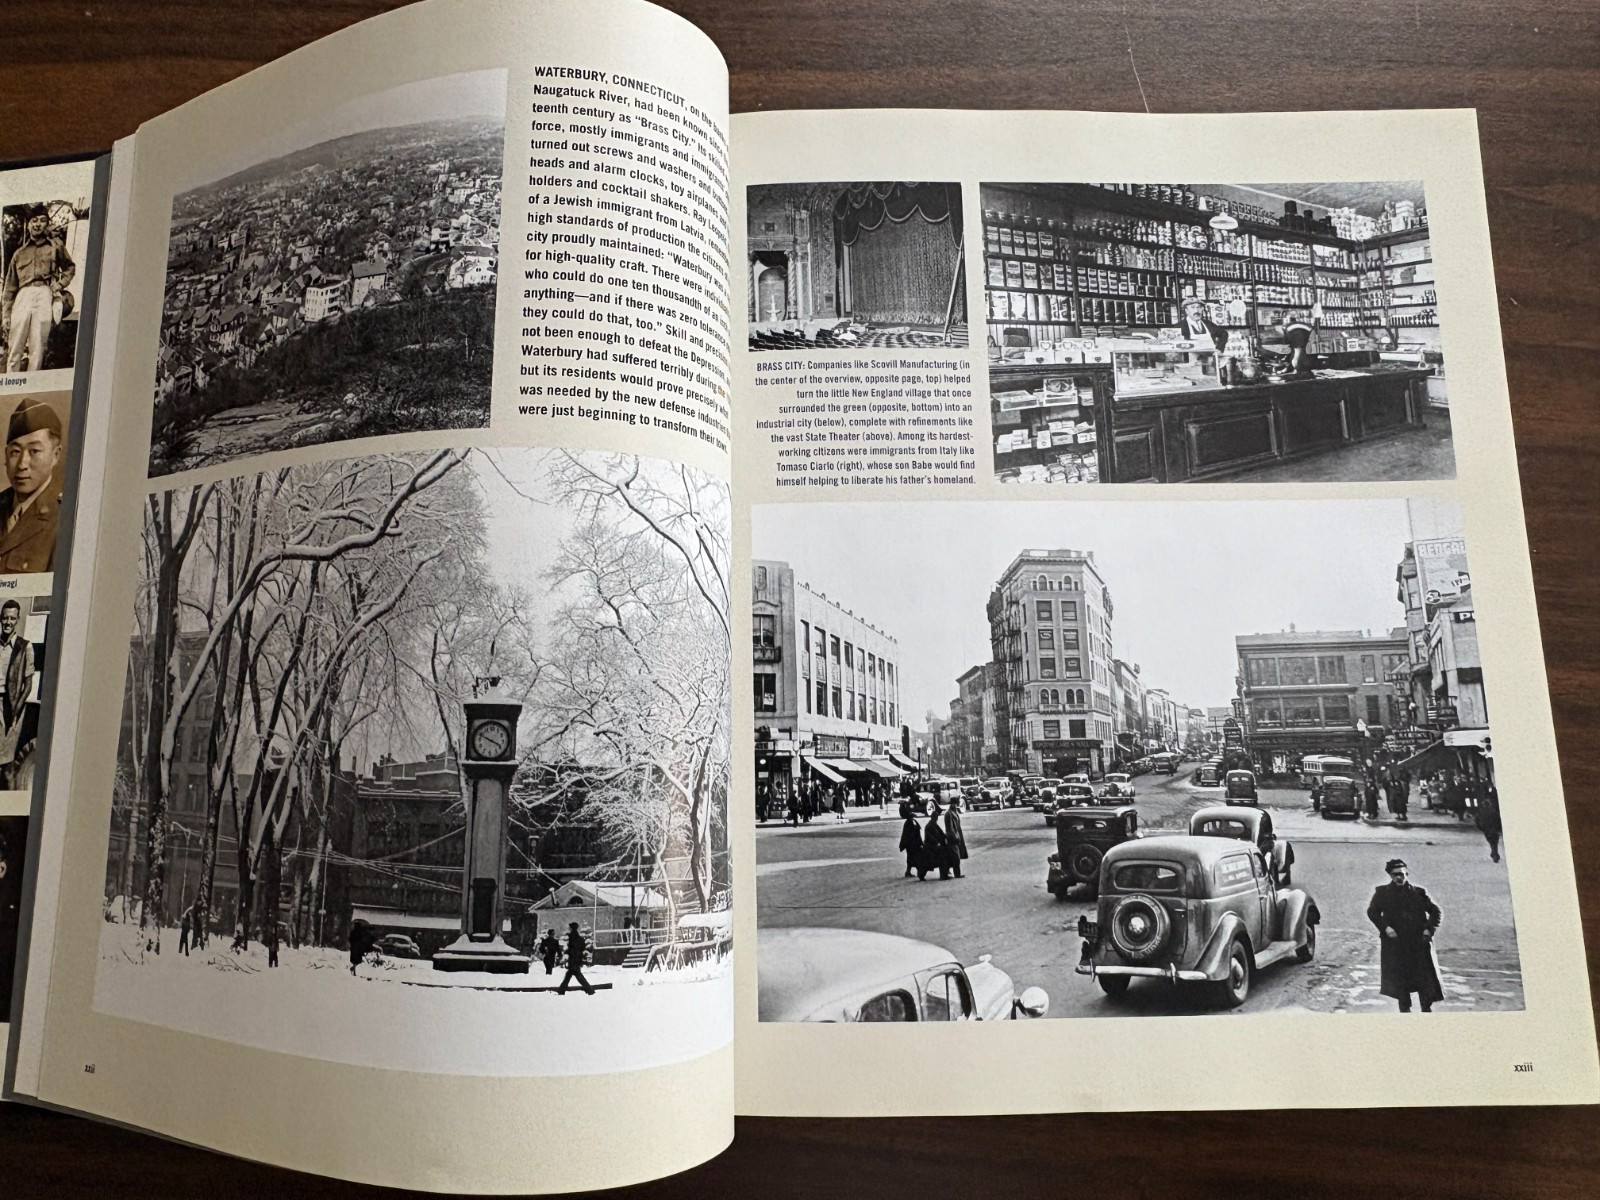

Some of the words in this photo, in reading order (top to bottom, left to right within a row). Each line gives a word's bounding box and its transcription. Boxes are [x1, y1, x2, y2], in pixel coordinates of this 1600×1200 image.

[535, 66, 608, 84] WATERBURY,
[533, 103, 568, 114] teenth
[573, 107, 615, 121] century
[619, 113, 631, 123] as
[534, 85, 595, 99] Naugatuck
[599, 90, 630, 107] River,
[634, 98, 653, 111] had
[657, 105, 680, 122] been
[532, 121, 565, 133] force,
[569, 124, 606, 138] mostly
[611, 129, 669, 153] immigrants
[673, 148, 689, 162] and
[531, 140, 567, 150] turned
[572, 142, 589, 152] out
[593, 145, 633, 160] screws
[637, 152, 656, 166] and
[659, 160, 696, 184] washers
[529, 176, 572, 187] holders
[576, 179, 598, 190] and
[602, 182, 647, 199] cocktail
[530, 157, 564, 168] heads
[568, 159, 589, 170] and
[593, 163, 626, 176] alarm
[630, 168, 668, 189] clocks,
[671, 181, 684, 196] toy
[528, 194, 540, 204] of
[543, 196, 549, 205] a
[554, 194, 593, 208] Jewish
[597, 198, 653, 219] immigrant
[656, 212, 677, 228] from
[527, 212, 552, 226] high
[556, 214, 613, 229] standards
[617, 221, 629, 232] of
[632, 224, 685, 248] production
[526, 232, 548, 244] city
[552, 234, 595, 247] proudly
[600, 238, 664, 259] maintained:
[525, 250, 542, 260] for
[545, 250, 615, 269] high-quality
[619, 259, 648, 273] craft.
[652, 265, 680, 282] There
[525, 269, 548, 279] who
[552, 270, 585, 281] could
[590, 273, 603, 284] do
[607, 277, 628, 288] one
[632, 280, 649, 292] ten
[615, 293, 622, 304] if
[626, 297, 653, 312] there
[657, 305, 676, 318] was
[679, 312, 698, 326] zero
[523, 307, 548, 319] they
[552, 309, 584, 319] could
[589, 310, 603, 321] do
[607, 313, 632, 327] that,
[665, 324, 686, 341] Skill
[522, 326, 541, 337] not
[545, 326, 573, 338] been
[578, 331, 620, 344] enough
[624, 336, 634, 345] to
[639, 338, 672, 354] defeat
[674, 346, 688, 359] the
[522, 345, 582, 360] Waterbury
[587, 349, 608, 360] had
[612, 353, 657, 369] suffered
[757, 362, 783, 371] BRASS
[808, 361, 852, 371] Companies
[854, 360, 869, 368] like
[871, 360, 897, 368] Scovill
[900, 360, 957, 370] Manufacturing
[521, 365, 539, 375] but
[543, 366, 557, 376] its
[562, 367, 616, 381] residents
[620, 372, 653, 387] would
[657, 380, 683, 395] prove
[755, 376, 769, 385] the
[770, 376, 797, 385] center
[810, 375, 822, 384] the
[865, 374, 899, 385] opposite
[944, 374, 970, 385] helped
[520, 385, 542, 395] was
[547, 386, 591, 398] needed
[595, 388, 608, 402] by
[613, 390, 630, 402] the
[634, 394, 656, 407] new
[797, 390, 813, 398] turn
[816, 389, 828, 398] the
[831, 389, 849, 397] little
[852, 389, 868, 397] New
[871, 389, 903, 399] England
[905, 389, 931, 399] village
[934, 389, 950, 397] that
[519, 406, 547, 415] were
[551, 405, 574, 417] just
[578, 406, 636, 425] beginning
[640, 414, 650, 425] to
[779, 404, 825, 413] surrounded
[828, 404, 841, 412] the
[843, 404, 867, 413] green
[945, 403, 960, 411] into
[756, 419, 795, 429] industrial
[797, 419, 812, 429] city
[849, 418, 886, 428] complete
[889, 417, 906, 426] with
[908, 417, 956, 426] refinements
[958, 417, 972, 425] like
[771, 433, 783, 442] the
[786, 433, 803, 442] vast
[806, 433, 826, 442] State
[829, 432, 860, 441] Theater
[898, 432, 925, 442] Among
[778, 448, 811, 458] working
[813, 447, 845, 456] citizens
[870, 446, 915, 456] immigrants
[918, 446, 937, 454] from
[939, 446, 957, 456] Italy
[960, 446, 974, 455] like
[777, 462, 807, 471] Tomaso
[810, 462, 834, 471] Ciarlo
[867, 461, 892, 469] whose
[912, 461, 932, 469] Babe
[935, 461, 958, 469] would
[960, 460, 975, 469] find
[776, 477, 806, 486] himself
[808, 476, 838, 487] helping
[851, 475, 883, 485] liberate
[900, 475, 931, 484] father's
[1513, 1061, 1534, 1073] xxiii
